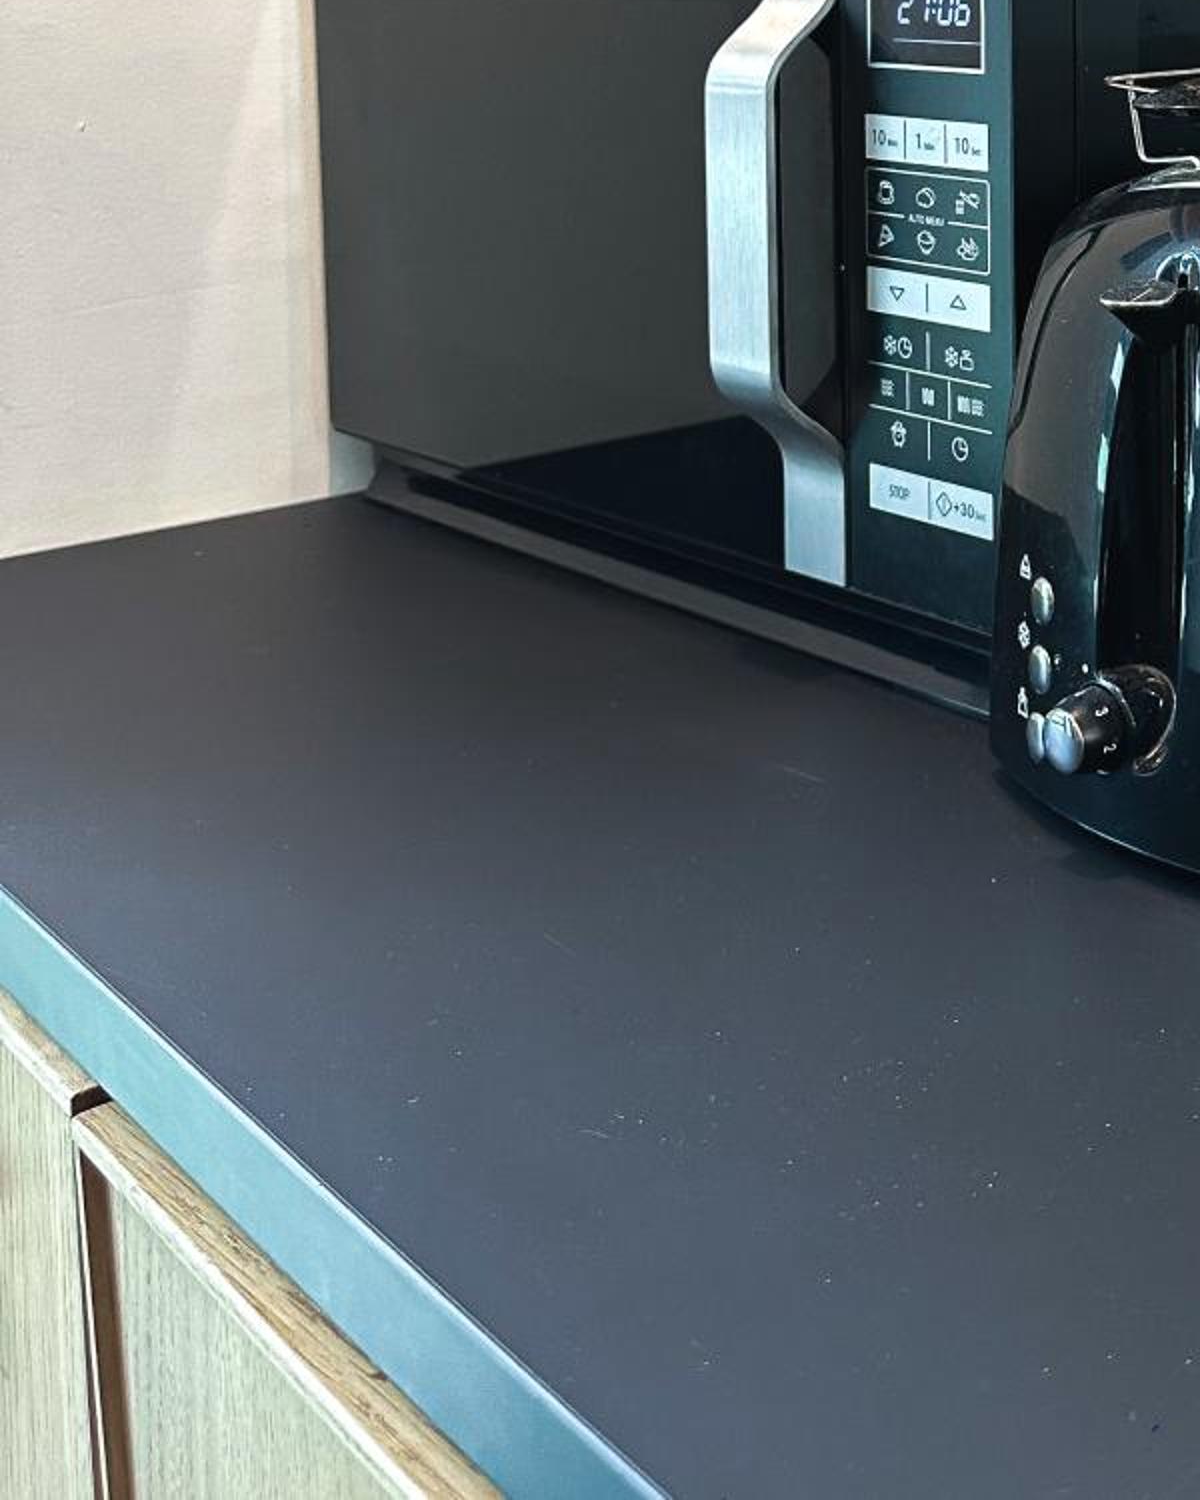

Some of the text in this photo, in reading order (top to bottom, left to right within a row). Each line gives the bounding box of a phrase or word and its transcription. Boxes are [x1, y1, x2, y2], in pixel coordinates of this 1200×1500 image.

[872, 128, 886, 146] 10
[915, 132, 922, 149] 1
[954, 136, 970, 155] 10
[889, 483, 911, 501] STOP
[953, 501, 975, 520] +30
